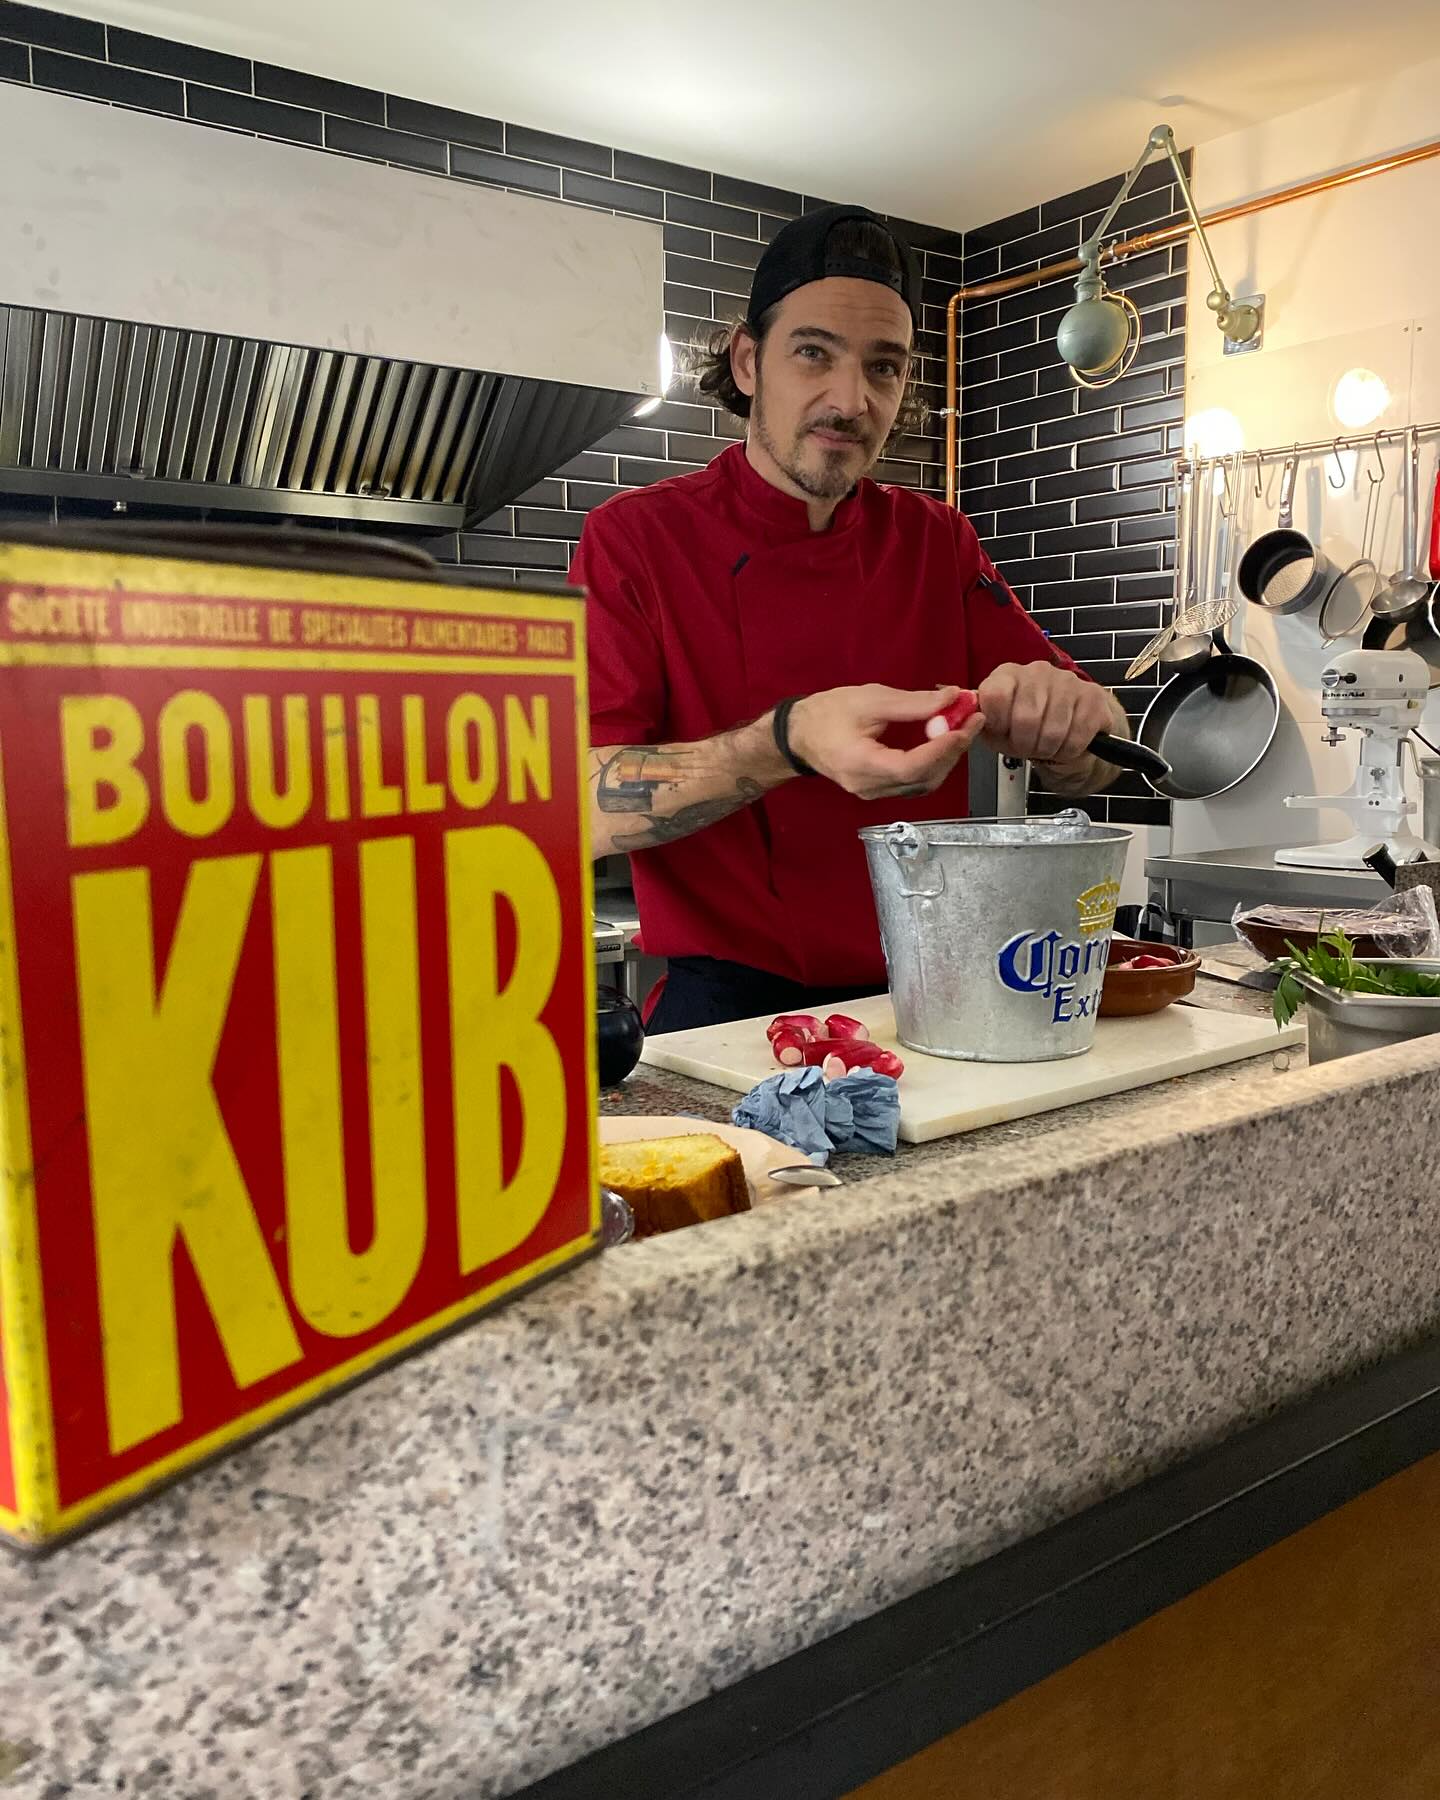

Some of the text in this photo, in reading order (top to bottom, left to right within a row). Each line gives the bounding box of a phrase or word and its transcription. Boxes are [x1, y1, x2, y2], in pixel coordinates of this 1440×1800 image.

[268, 607, 294, 643] DE
[60, 690, 554, 848] BOUILLON
[1052, 984, 1101, 1024] Ext
[71, 824, 569, 1456] KUB
